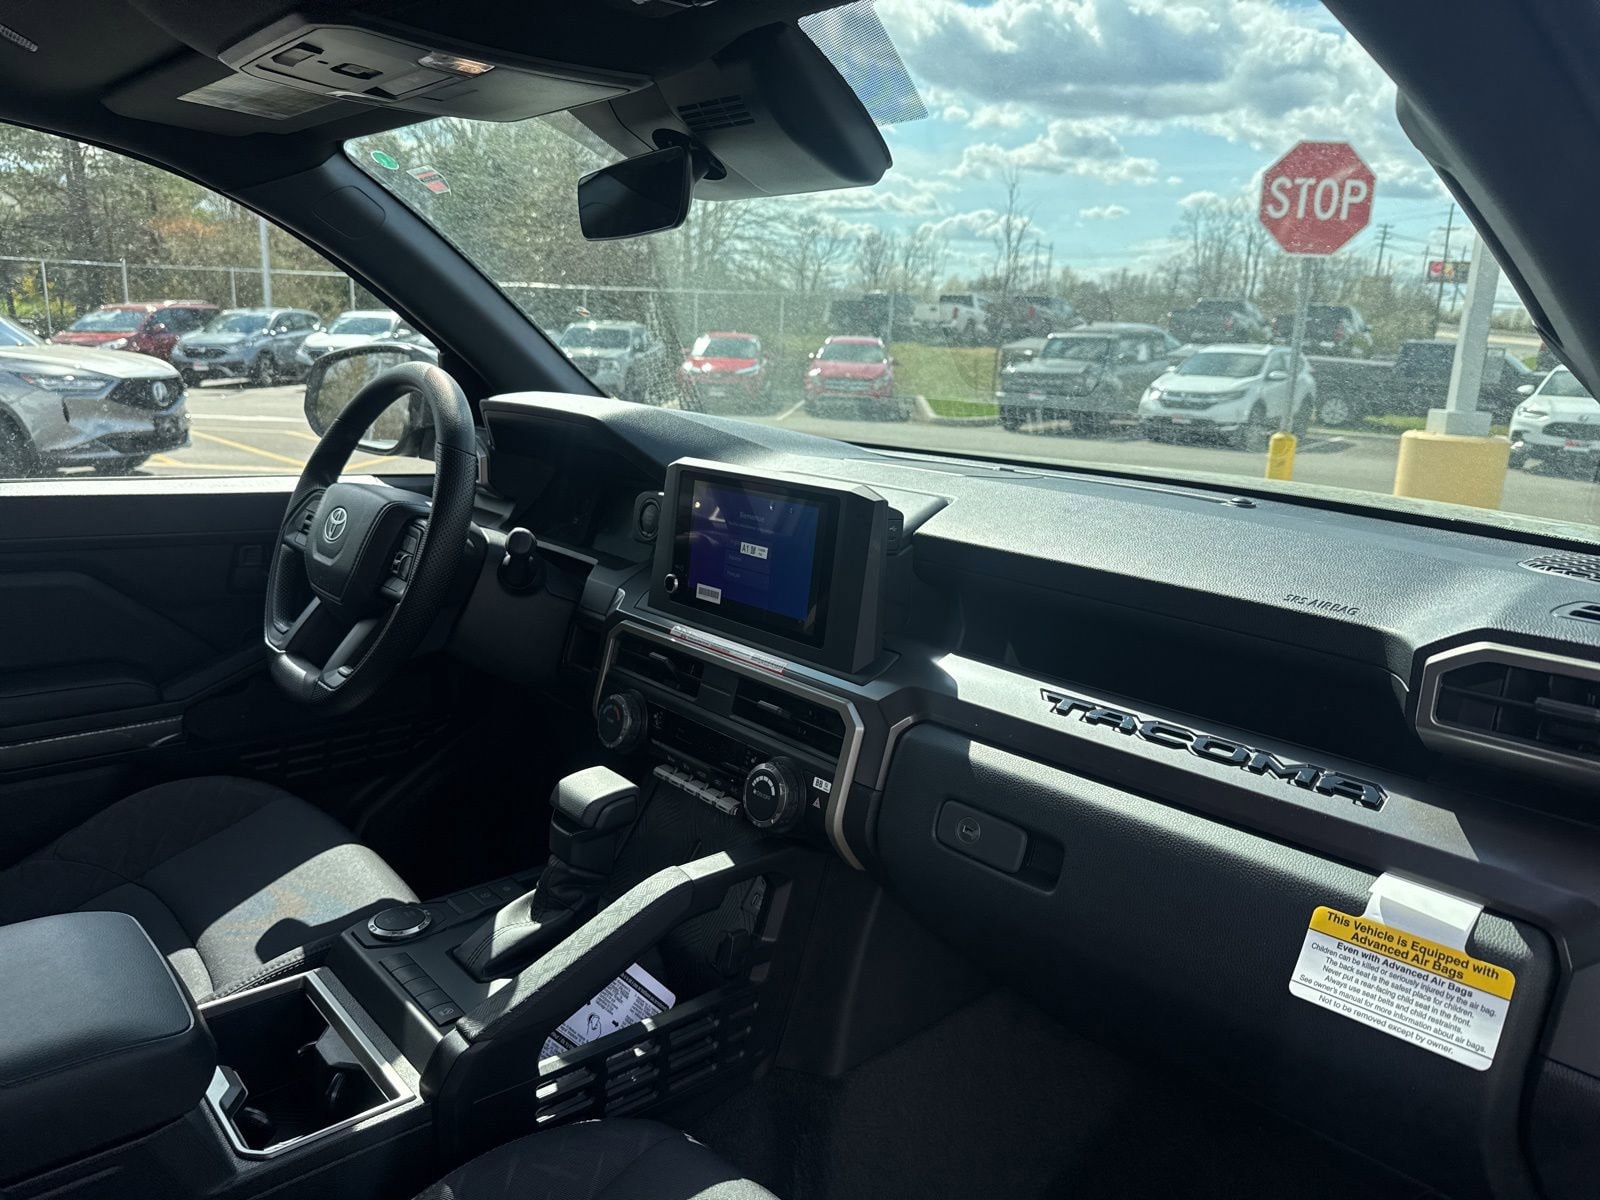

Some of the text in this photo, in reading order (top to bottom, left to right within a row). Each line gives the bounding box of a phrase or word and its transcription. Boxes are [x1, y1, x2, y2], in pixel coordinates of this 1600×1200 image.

[1266, 175, 1368, 221] STOP
[1284, 594, 1360, 615] SRS AIRBAG
[1040, 688, 1390, 812] TACOMA
[1327, 911, 1499, 979] This Vehicle is Equipped with
[1336, 942, 1472, 997] Even with Advanced Air Bags
[1350, 932, 1463, 979] Advanced Air Bags
[1311, 942, 1337, 957] Children
[1338, 953, 1351, 962] can
[1361, 960, 1380, 973] killed
[1388, 971, 1419, 989] seriously
[1420, 982, 1445, 997] injured
[1456, 996, 1468, 1005] the
[1469, 1001, 1479, 1009] air
[1480, 1004, 1496, 1017] bag.
[1322, 964, 1341, 977] Never
[1341, 973, 1353, 982] put
[1360, 980, 1396, 999] rear-facing
[1396, 994, 1414, 1005] child
[1414, 1000, 1430, 1011] seat
[1439, 1009, 1451, 1019] the
[1452, 1014, 1470, 1026] front.
[1324, 975, 1462, 1033] Always use seat belts and child restraints.
[1326, 956, 1338, 966] The
[1338, 961, 1355, 973] back
[1355, 969, 1370, 979] seat
[1378, 976, 1389, 986] the
[1390, 982, 1412, 994] safest
[1411, 990, 1431, 1002] place
[1432, 996, 1443, 1006] for
[1443, 1002, 1473, 1018] children.
[1299, 974, 1486, 1053] See owner's manual for more information about air bags.
[1318, 994, 1332, 1005] Not
[1353, 1009, 1387, 1027] removed
[1387, 1023, 1414, 1038] except
[1426, 1039, 1453, 1054] owner.
